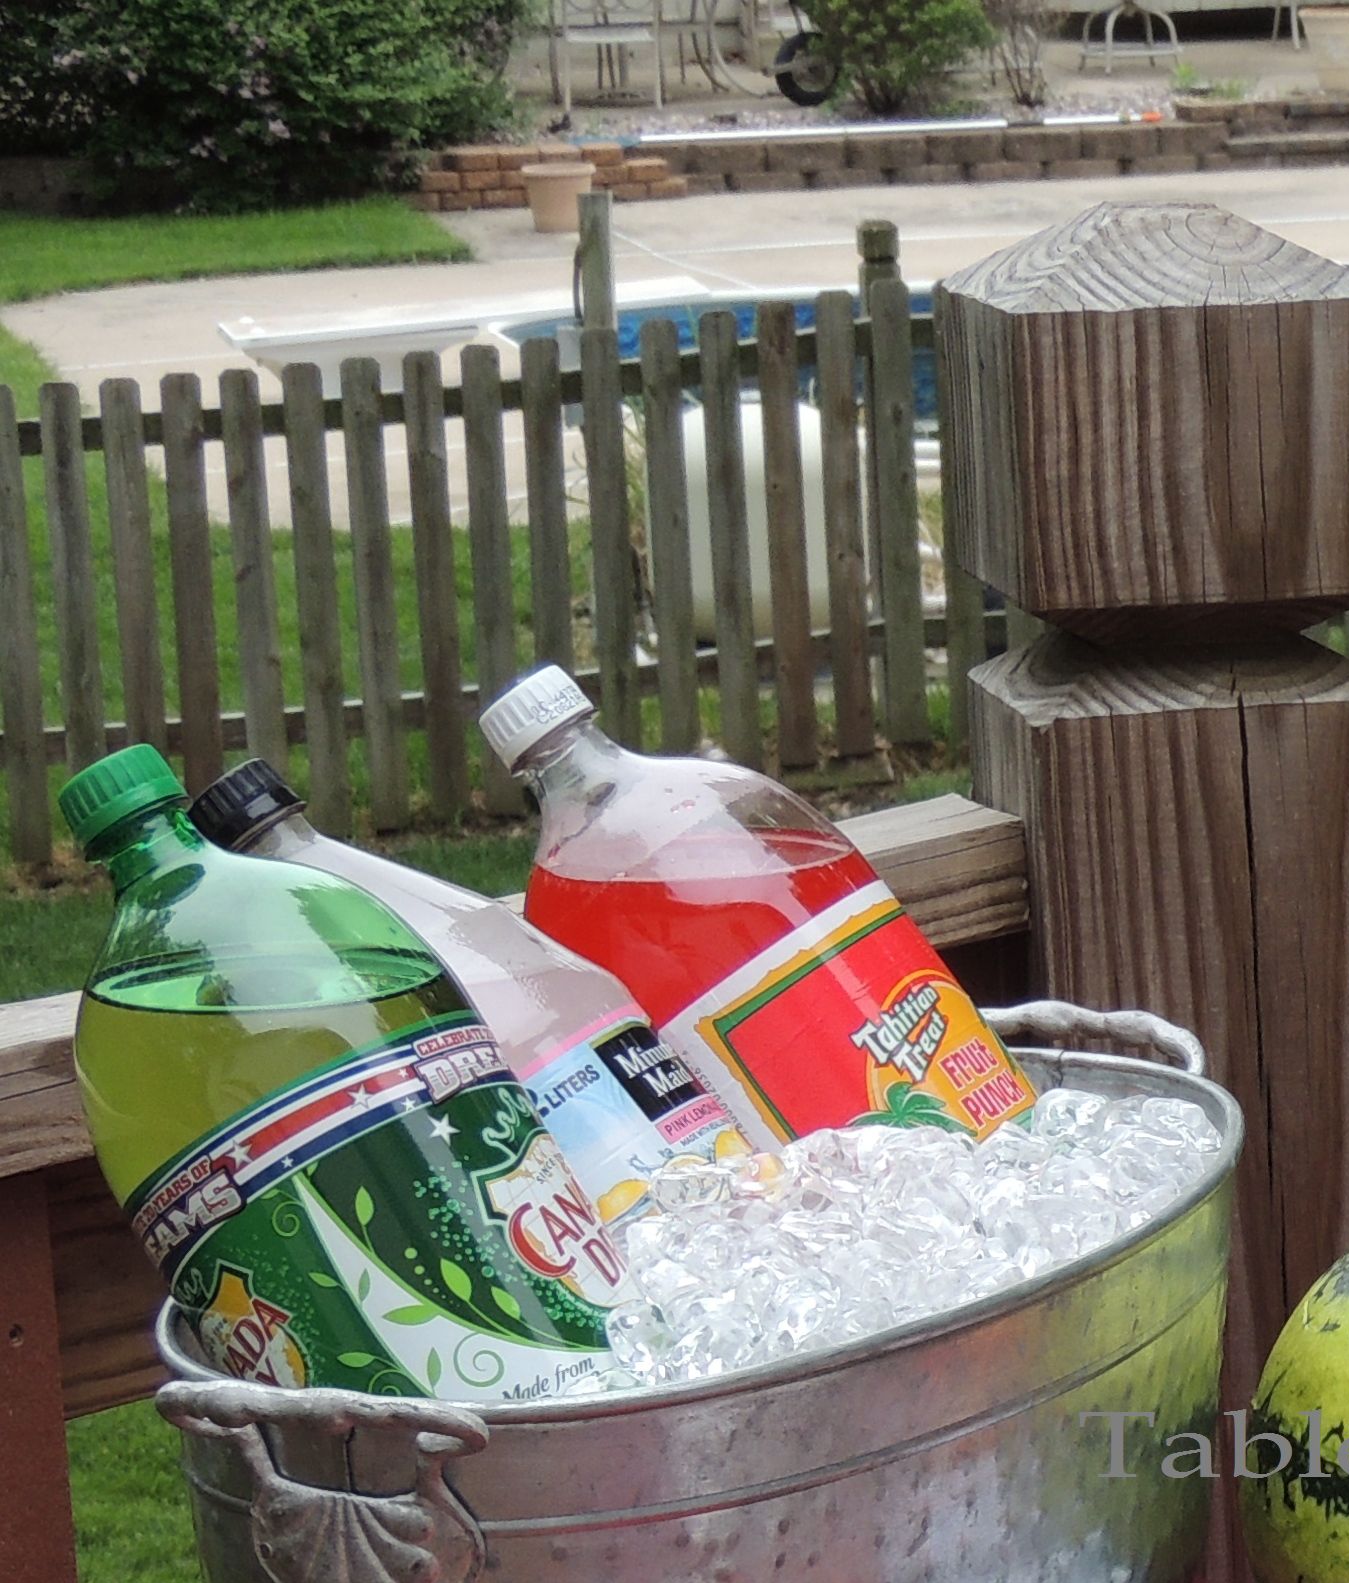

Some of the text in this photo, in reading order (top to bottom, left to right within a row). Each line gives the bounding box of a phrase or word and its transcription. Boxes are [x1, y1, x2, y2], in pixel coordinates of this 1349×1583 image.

[849, 985, 940, 1065] Tahitian
[893, 1010, 946, 1083] Treat
[550, 1064, 601, 1110] LITERS
[642, 1059, 694, 1098] Maid
[664, 1114, 692, 1137] PINK
[152, 1172, 193, 1209] YEARS
[190, 1158, 211, 1180] OF
[536, 1157, 557, 1185] SINCE
[222, 1298, 291, 1378] ADA
[554, 1356, 596, 1393] from
